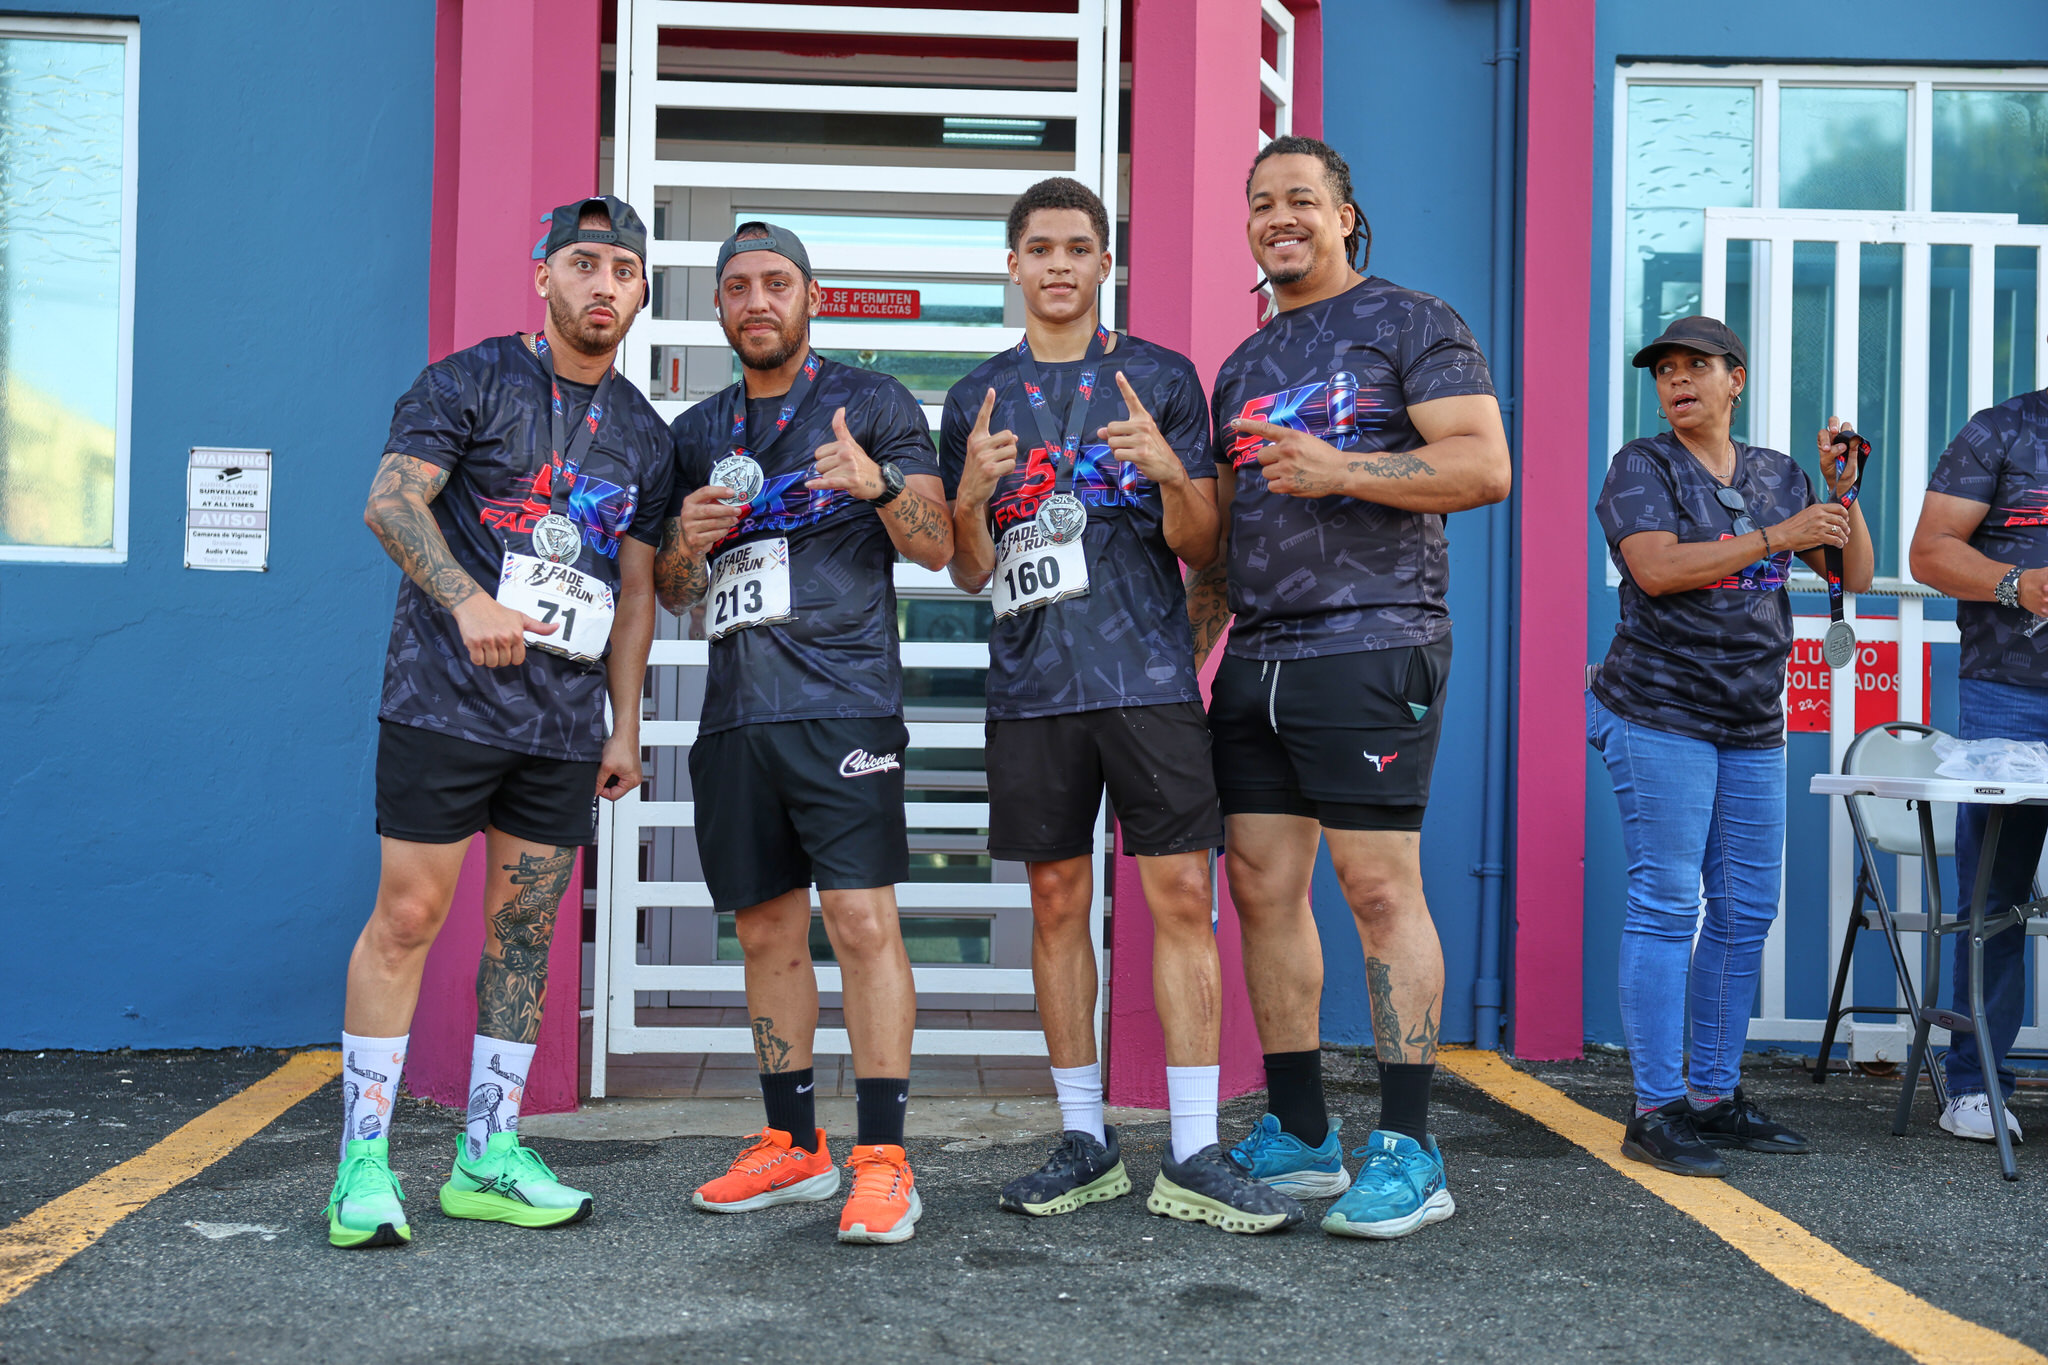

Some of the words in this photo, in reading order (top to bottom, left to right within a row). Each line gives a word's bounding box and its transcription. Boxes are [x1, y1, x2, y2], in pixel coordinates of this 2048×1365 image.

[820, 303, 846, 313] NTAS
[850, 305, 859, 313] NI
[863, 305, 912, 315] COLECTAS
[833, 291, 848, 302] SE
[853, 292, 912, 305] PERMITEN
[1234, 382, 1328, 451] 5K
[193, 453, 266, 466] WARNING
[199, 513, 256, 526] AVISO
[480, 507, 541, 533] FAD
[232, 531, 262, 540] Vigilancia
[1008, 525, 1039, 548] FADE
[724, 547, 752, 567] FADE
[729, 565, 736, 575] &
[736, 557, 764, 575] RUN
[549, 566, 585, 588] FADE
[1004, 556, 1061, 602] 160
[556, 582, 566, 592] &
[565, 586, 595, 604] RUN
[714, 579, 763, 626] 213
[537, 599, 577, 642] 71
[1787, 670, 1899, 693] OLEADOS
[839, 748, 900, 778] Chicago
